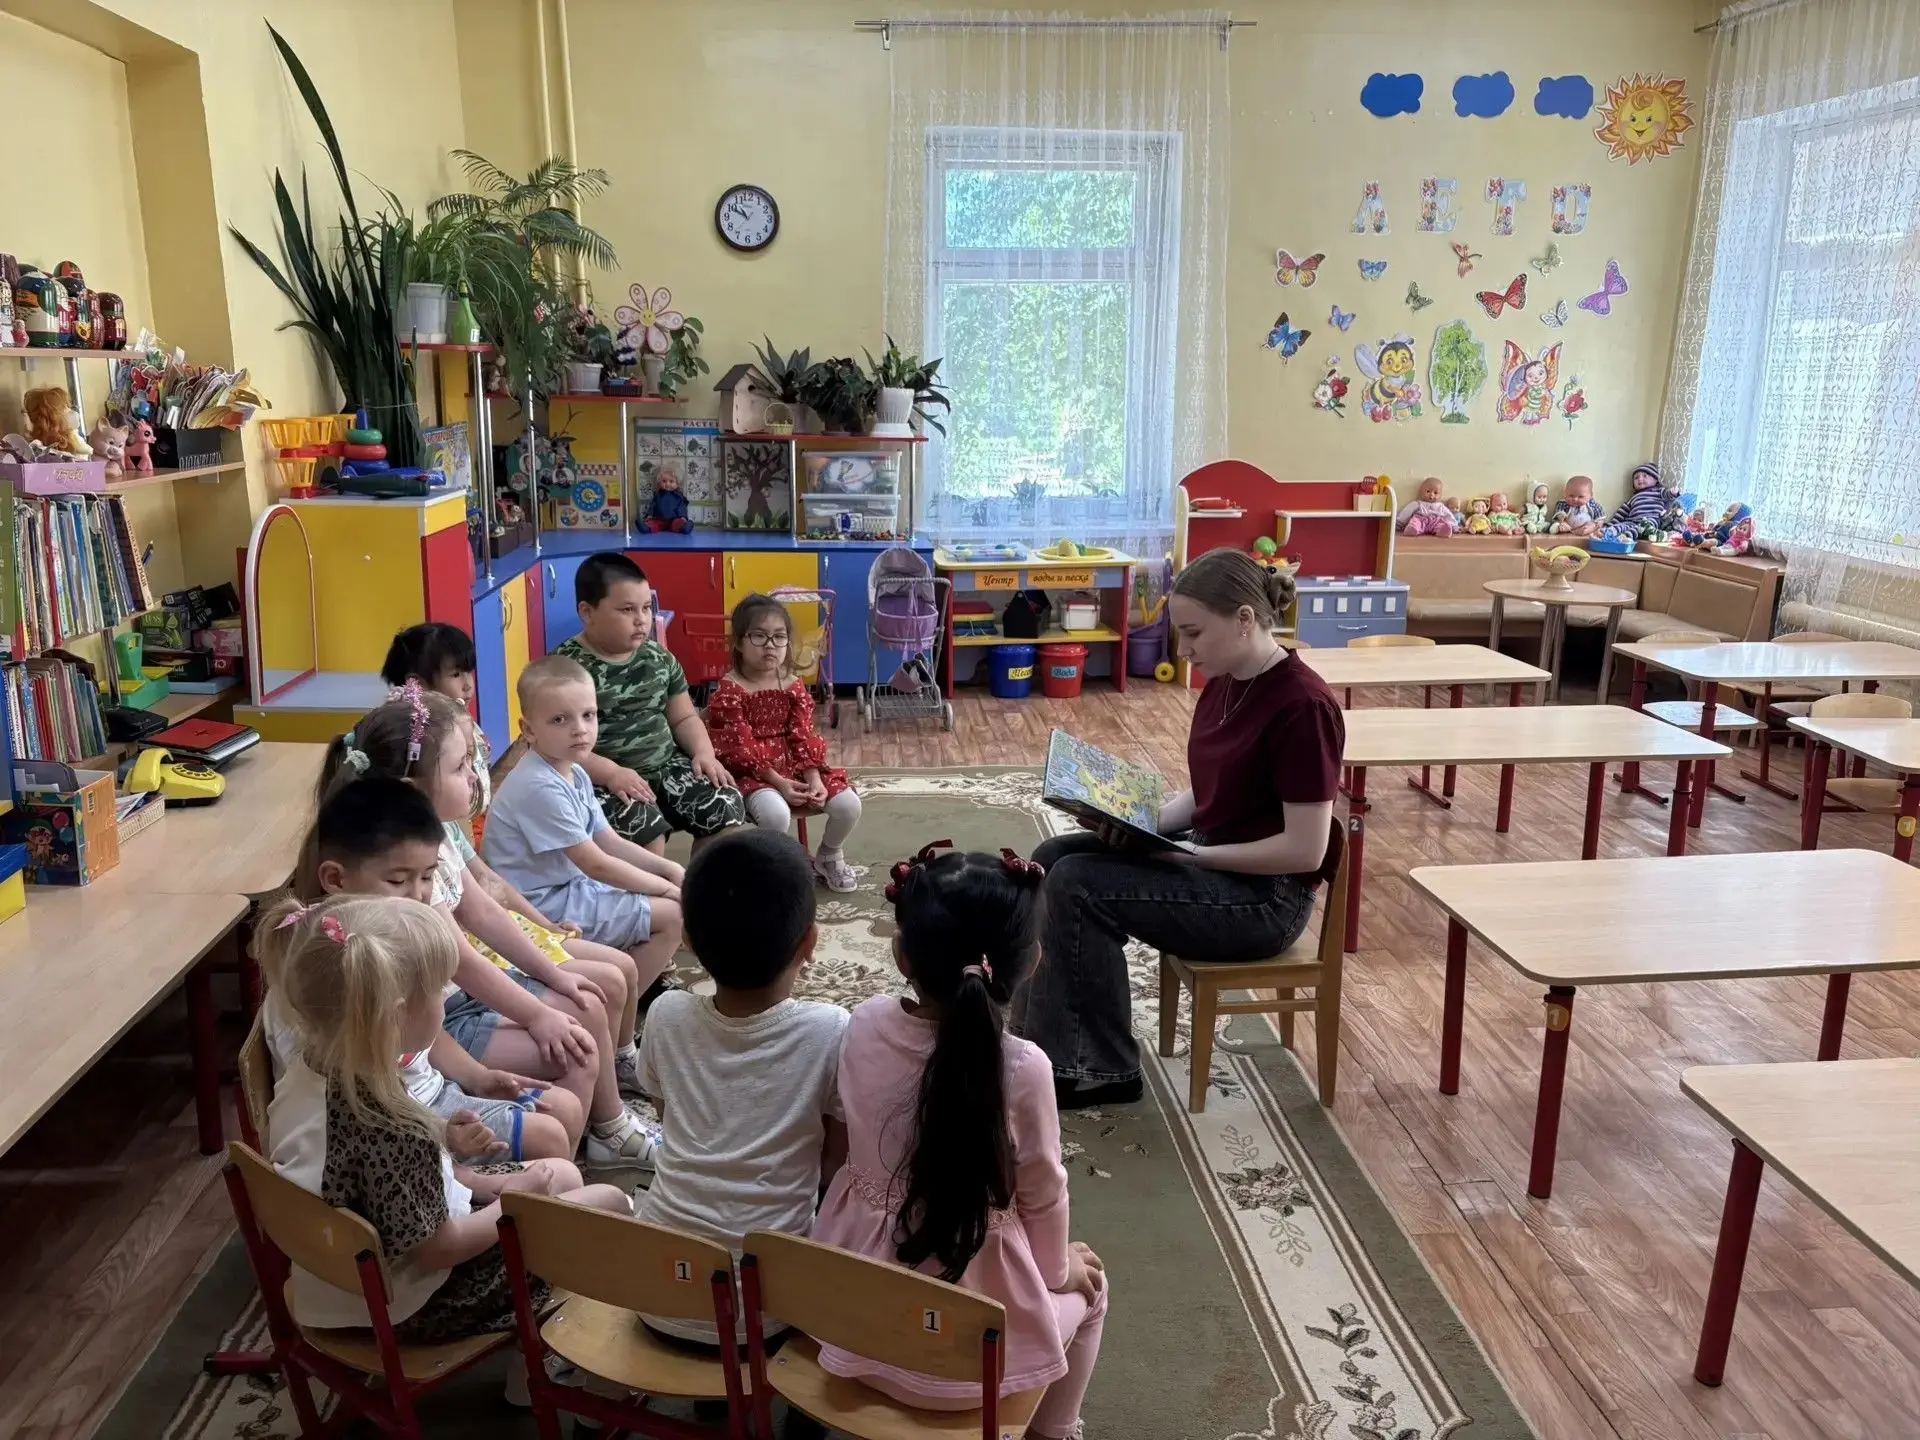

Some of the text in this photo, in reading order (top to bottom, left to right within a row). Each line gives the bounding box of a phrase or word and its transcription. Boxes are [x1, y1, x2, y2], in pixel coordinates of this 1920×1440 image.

[735, 194, 743, 204] 11
[743, 190, 754, 201] 12
[762, 205, 769, 214] 2
[1350, 177, 1592, 236] ЛЕТО
[724, 212, 730, 221] 9
[766, 215, 773, 223] 3
[727, 222, 733, 231] 8
[734, 230, 740, 239] 7
[744, 235, 751, 243] 6
[756, 232, 762, 241] 5
[982, 575, 1014, 587] Центр
[1033, 571, 1055, 582] воды
[1065, 574, 1089, 583] песка
[1350, 819, 1359, 831] 2
[676, 1262, 691, 1281] 1
[924, 1311, 938, 1331] 1
